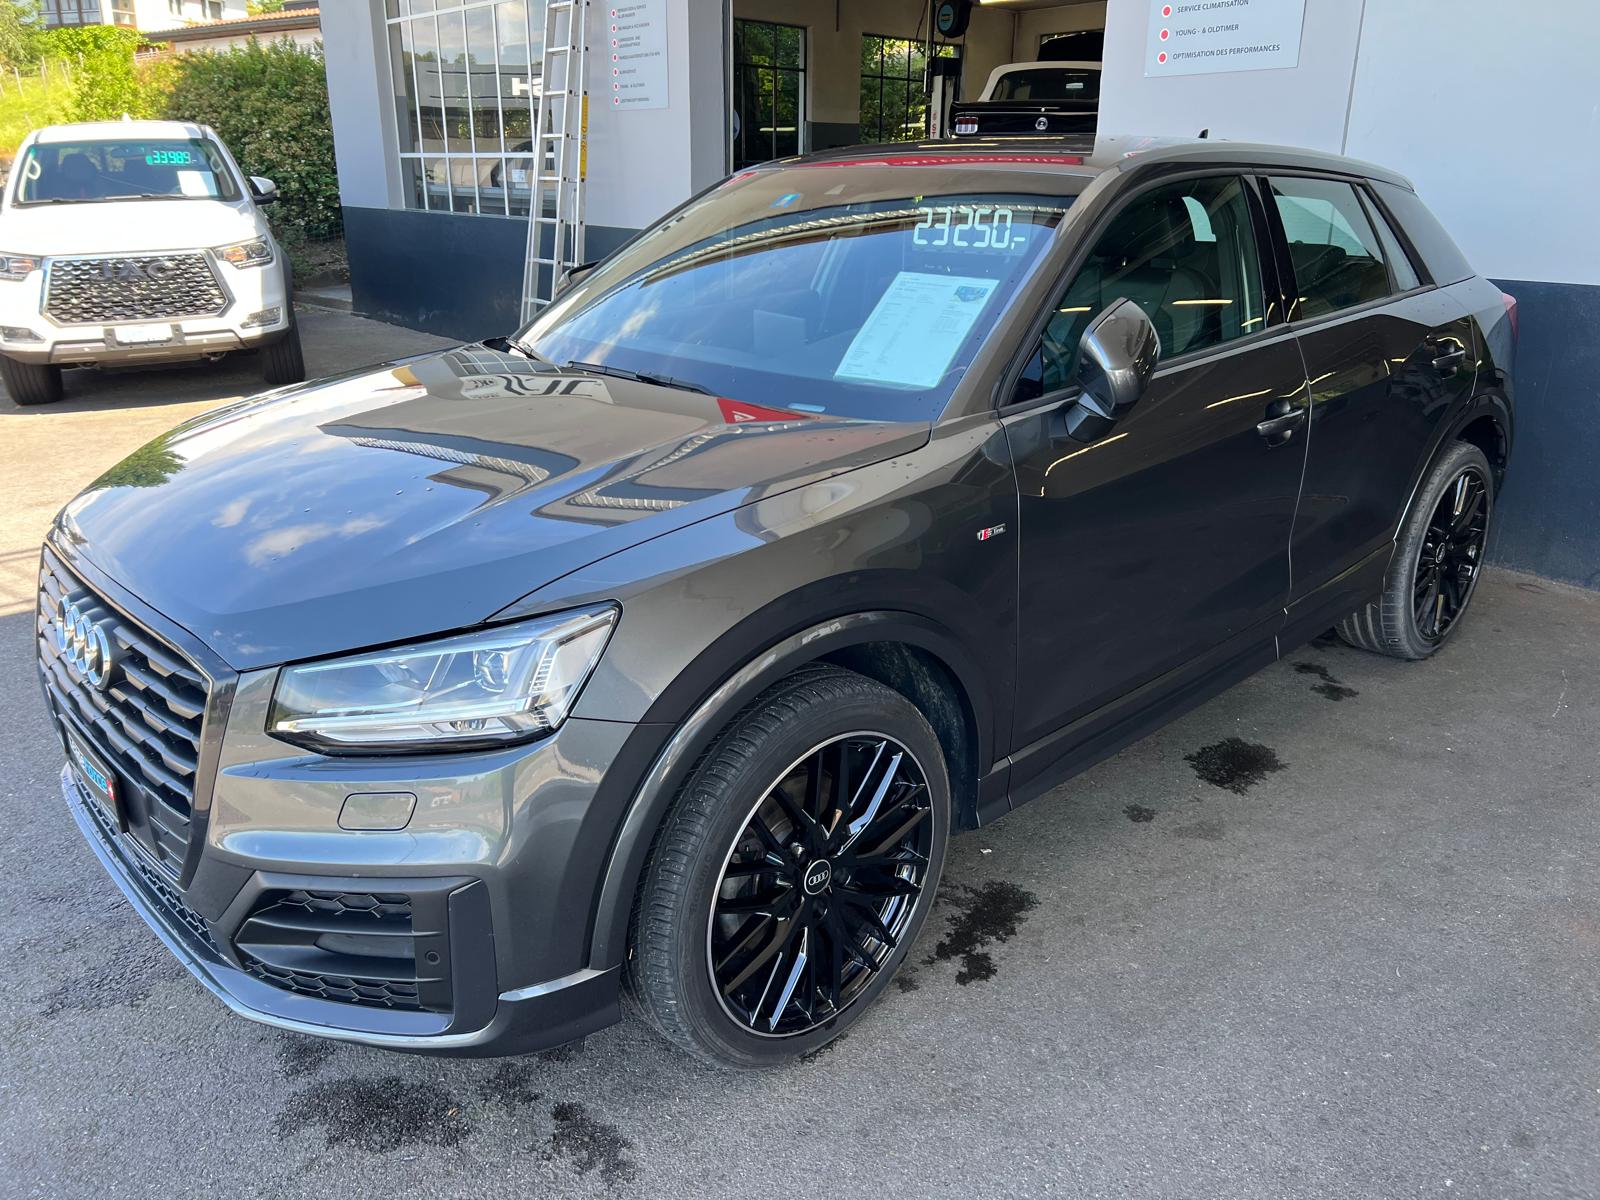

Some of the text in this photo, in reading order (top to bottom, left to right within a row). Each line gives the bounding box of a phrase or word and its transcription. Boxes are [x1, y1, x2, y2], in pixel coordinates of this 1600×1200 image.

[1177, 0, 1249, 13] SERVICE CLIMATISATION
[1207, 23, 1240, 33] OLDTIMER
[1173, 44, 1281, 60] OPTIMISATION DES PERFORMANCES
